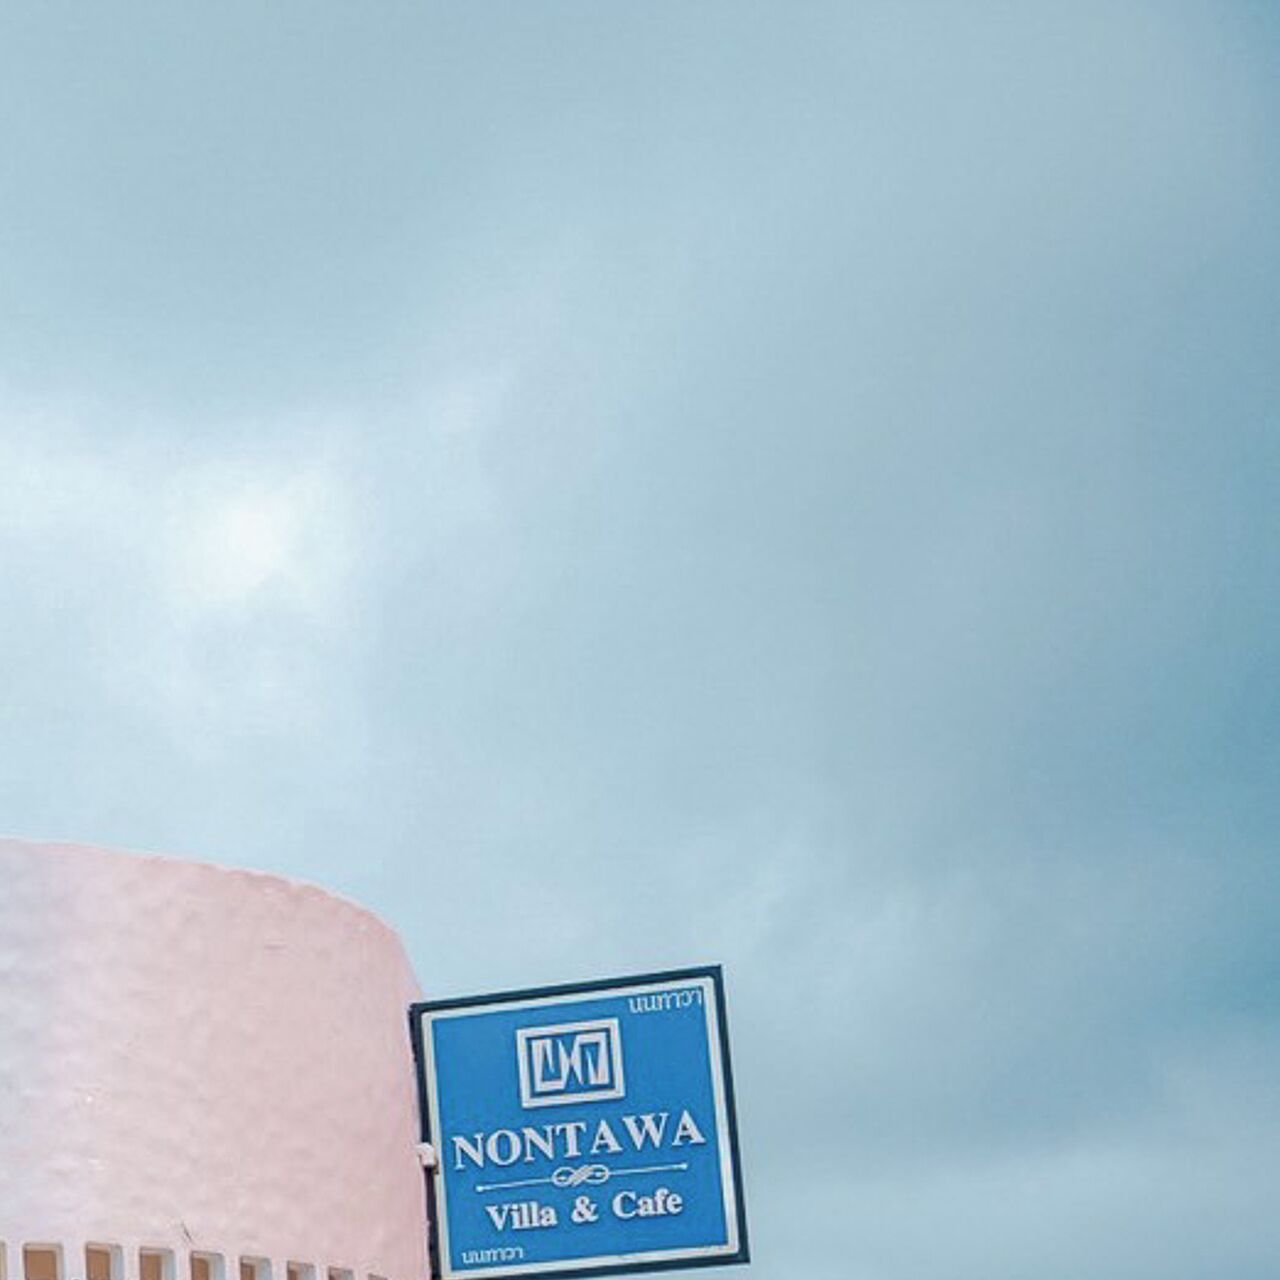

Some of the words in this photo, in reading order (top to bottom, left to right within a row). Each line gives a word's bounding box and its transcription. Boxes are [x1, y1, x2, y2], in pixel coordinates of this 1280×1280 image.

[452, 1110, 705, 1170] NONTAWA
[485, 1201, 557, 1231] Villa
[571, 1196, 598, 1224] &
[612, 1188, 683, 1218] Cafe
